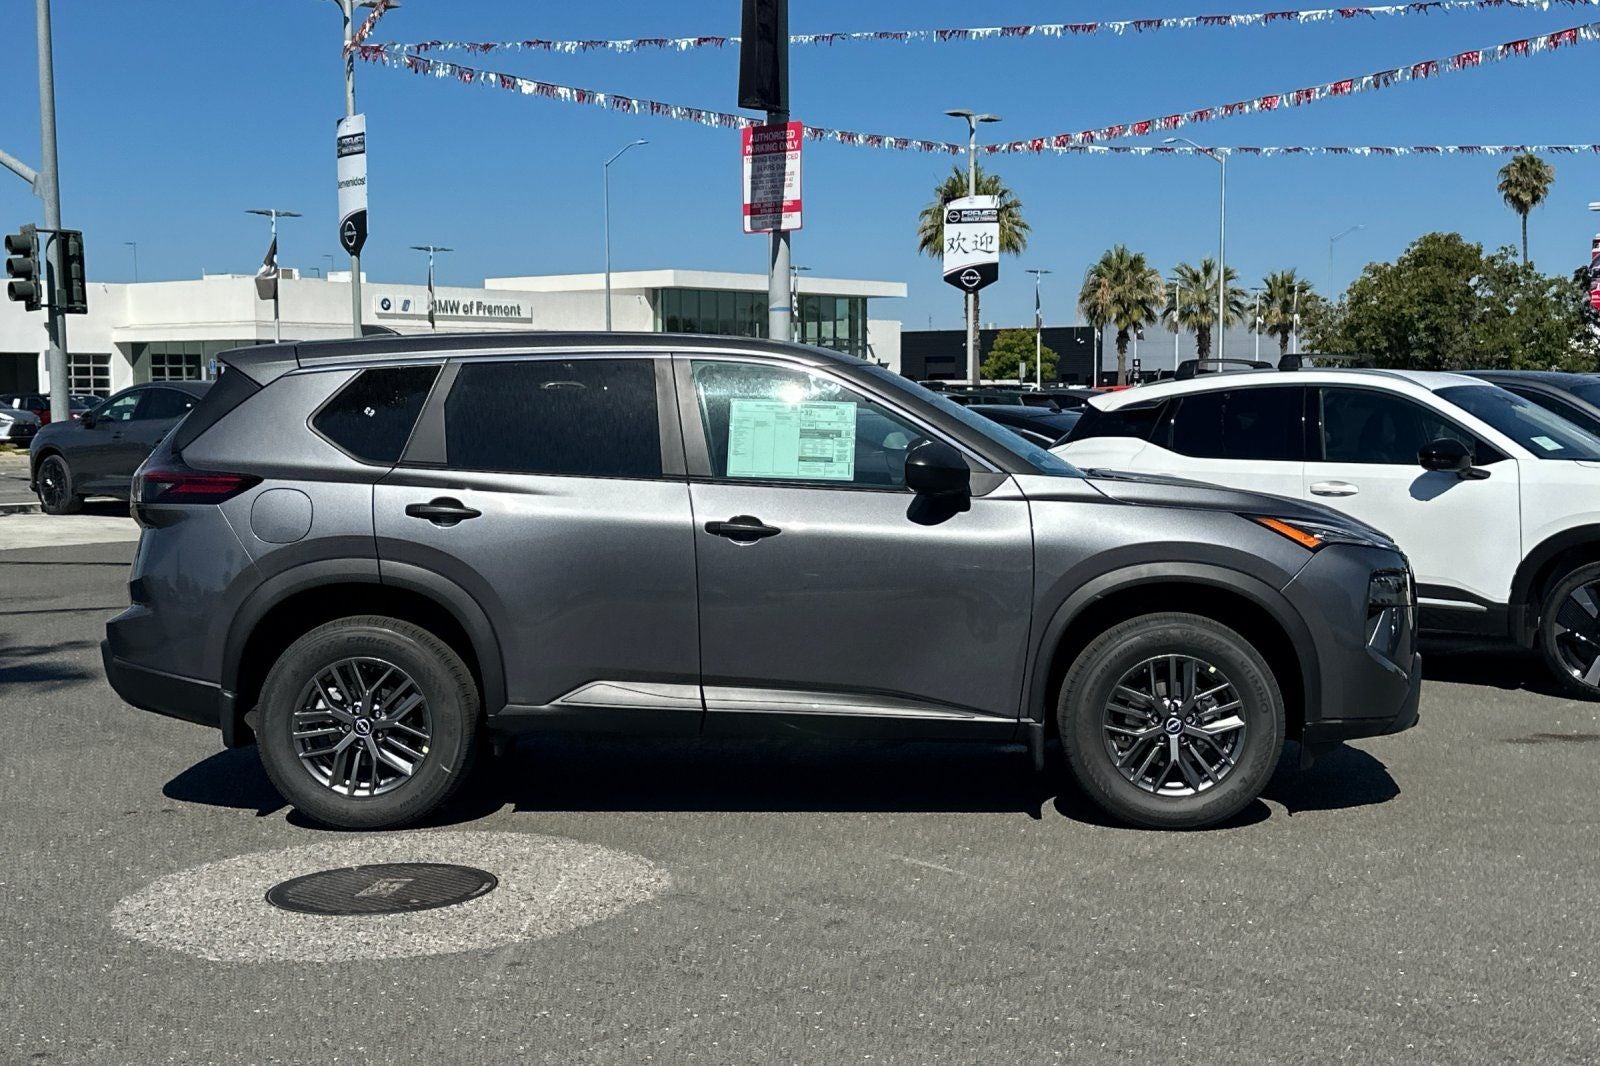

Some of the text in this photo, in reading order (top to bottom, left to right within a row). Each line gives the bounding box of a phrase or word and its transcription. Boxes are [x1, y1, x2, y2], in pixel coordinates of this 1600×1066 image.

[749, 130, 795, 143] AUTHORIZED
[745, 139, 799, 154] PARKING ONLY
[945, 231, 997, 254] 欢迎
[463, 300, 474, 315] of
[476, 301, 521, 316] Fremont
